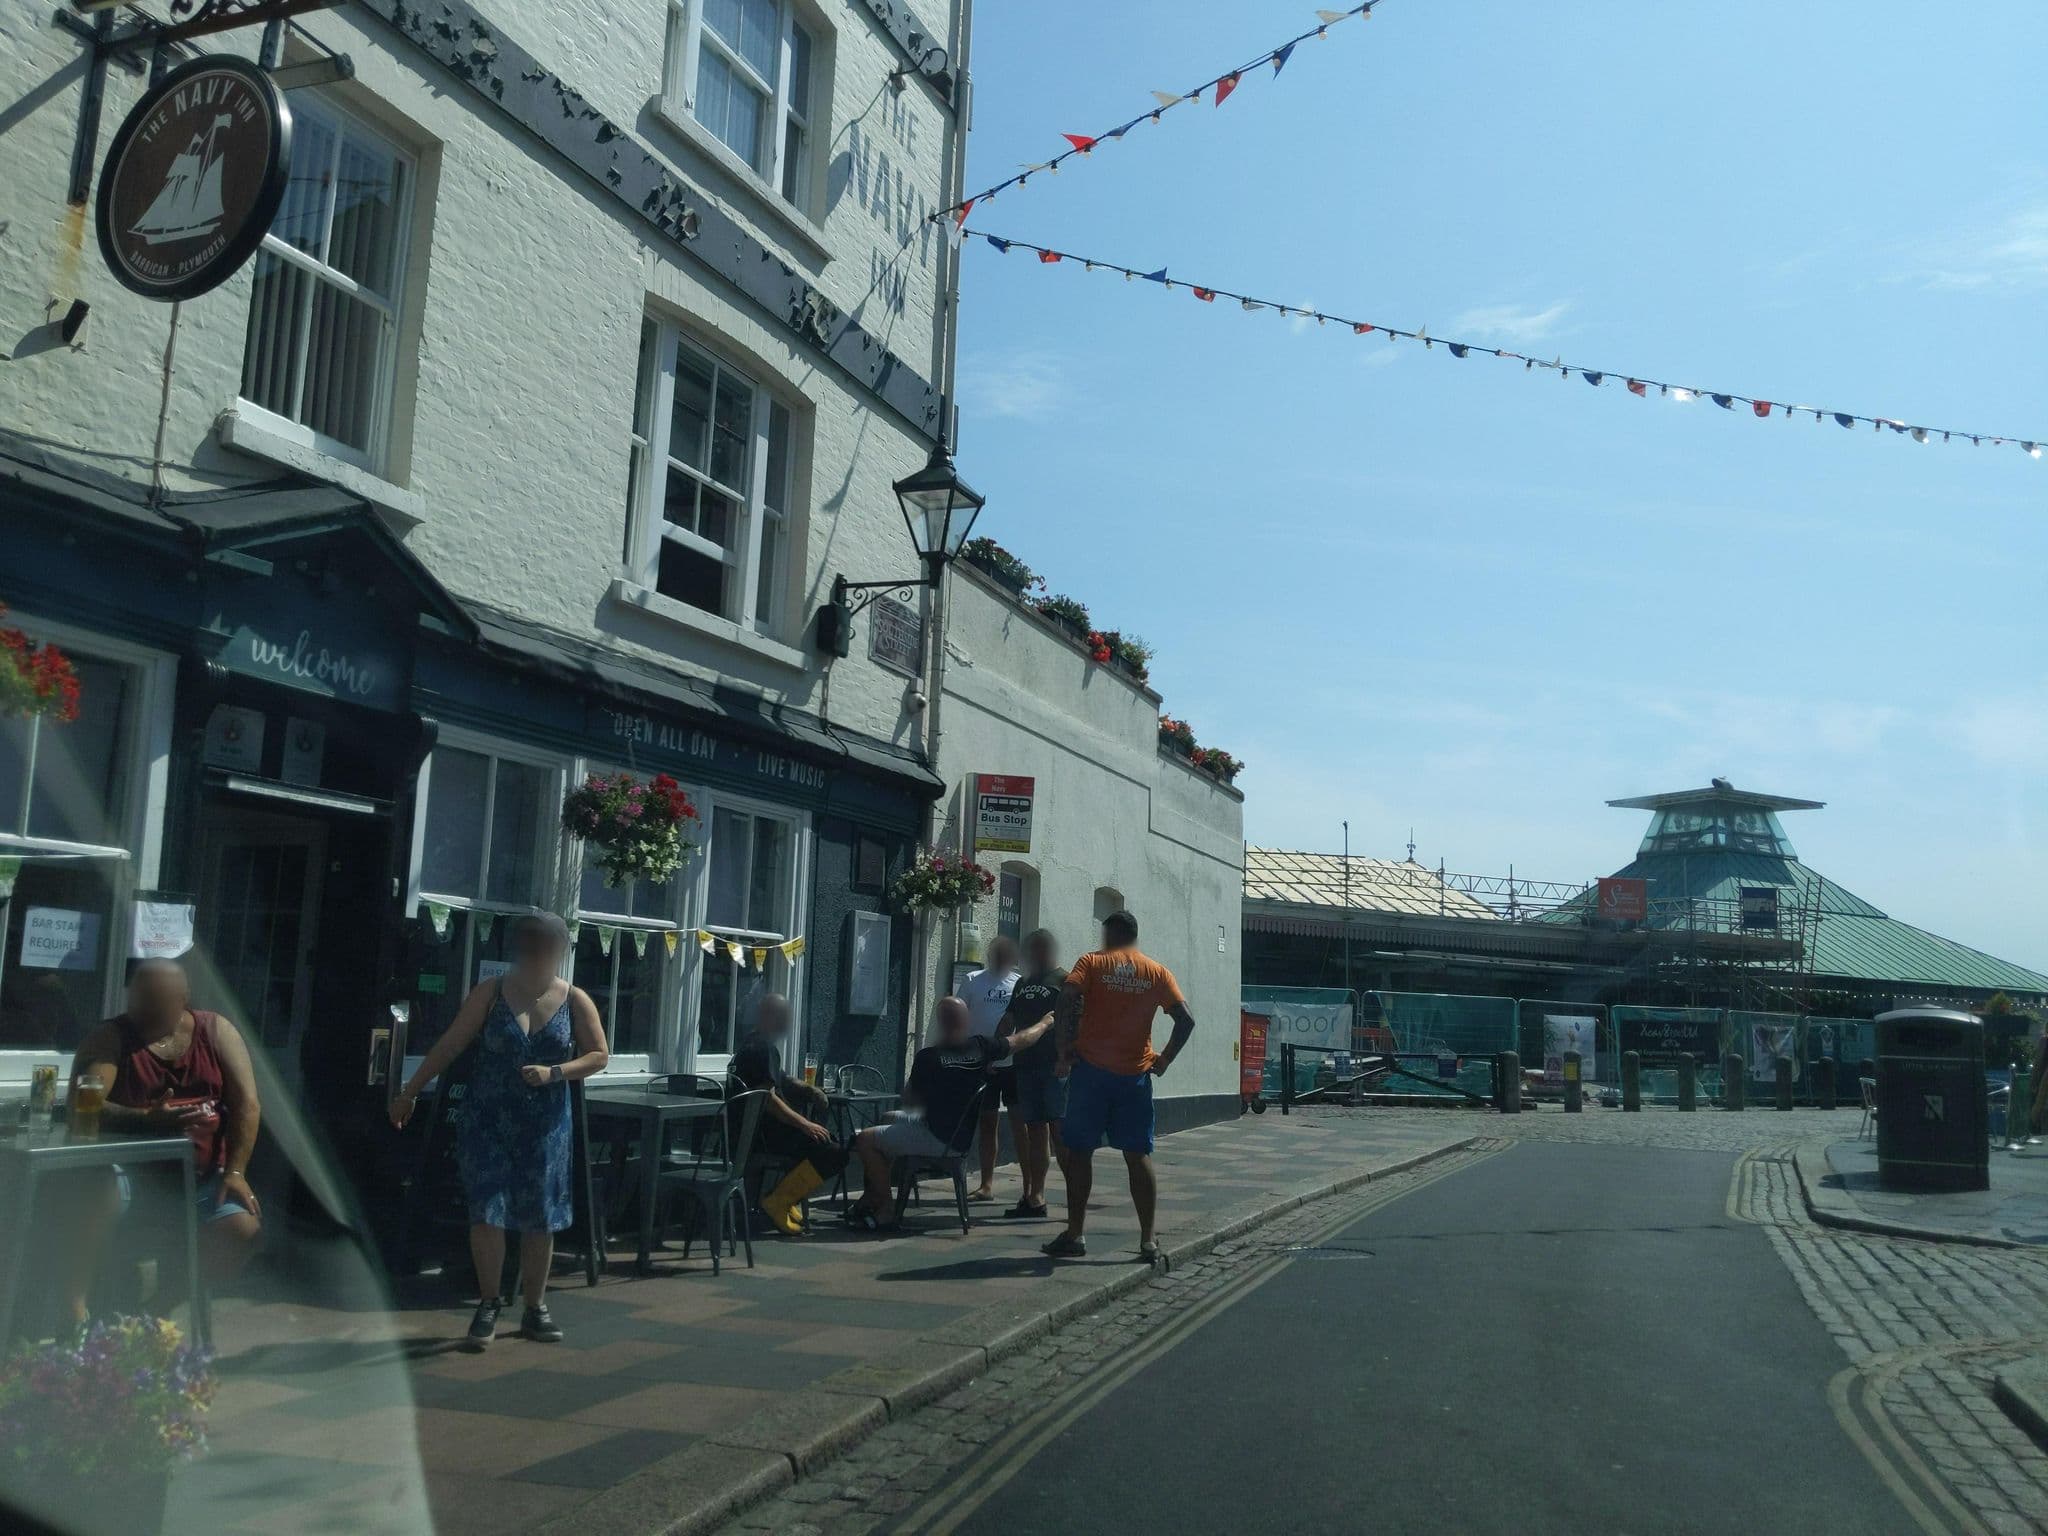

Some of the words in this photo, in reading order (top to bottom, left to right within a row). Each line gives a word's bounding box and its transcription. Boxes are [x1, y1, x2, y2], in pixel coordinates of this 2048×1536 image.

[142, 110, 169, 144] THE
[174, 79, 236, 118] NAVY
[234, 93, 257, 124] INN
[881, 78, 919, 161] THE
[847, 119, 937, 269] NAVY
[130, 249, 171, 277] BARBICAN
[178, 235, 227, 275] PLYMOUTH
[871, 246, 905, 321] INN
[252, 630, 376, 695] welcome
[614, 712, 652, 744] OPEN
[659, 724, 685, 753] ALL
[691, 735, 718, 761] DAY
[758, 752, 785, 779] LIVE
[790, 760, 826, 790] MUSIC
[981, 813, 1001, 823] Bus
[1004, 814, 1027, 827] Stop
[32, 918, 53, 929] BAR
[1015, 984, 1051, 998] LACOSTE
[1102, 974, 1152, 990] SCAFFOLDING
